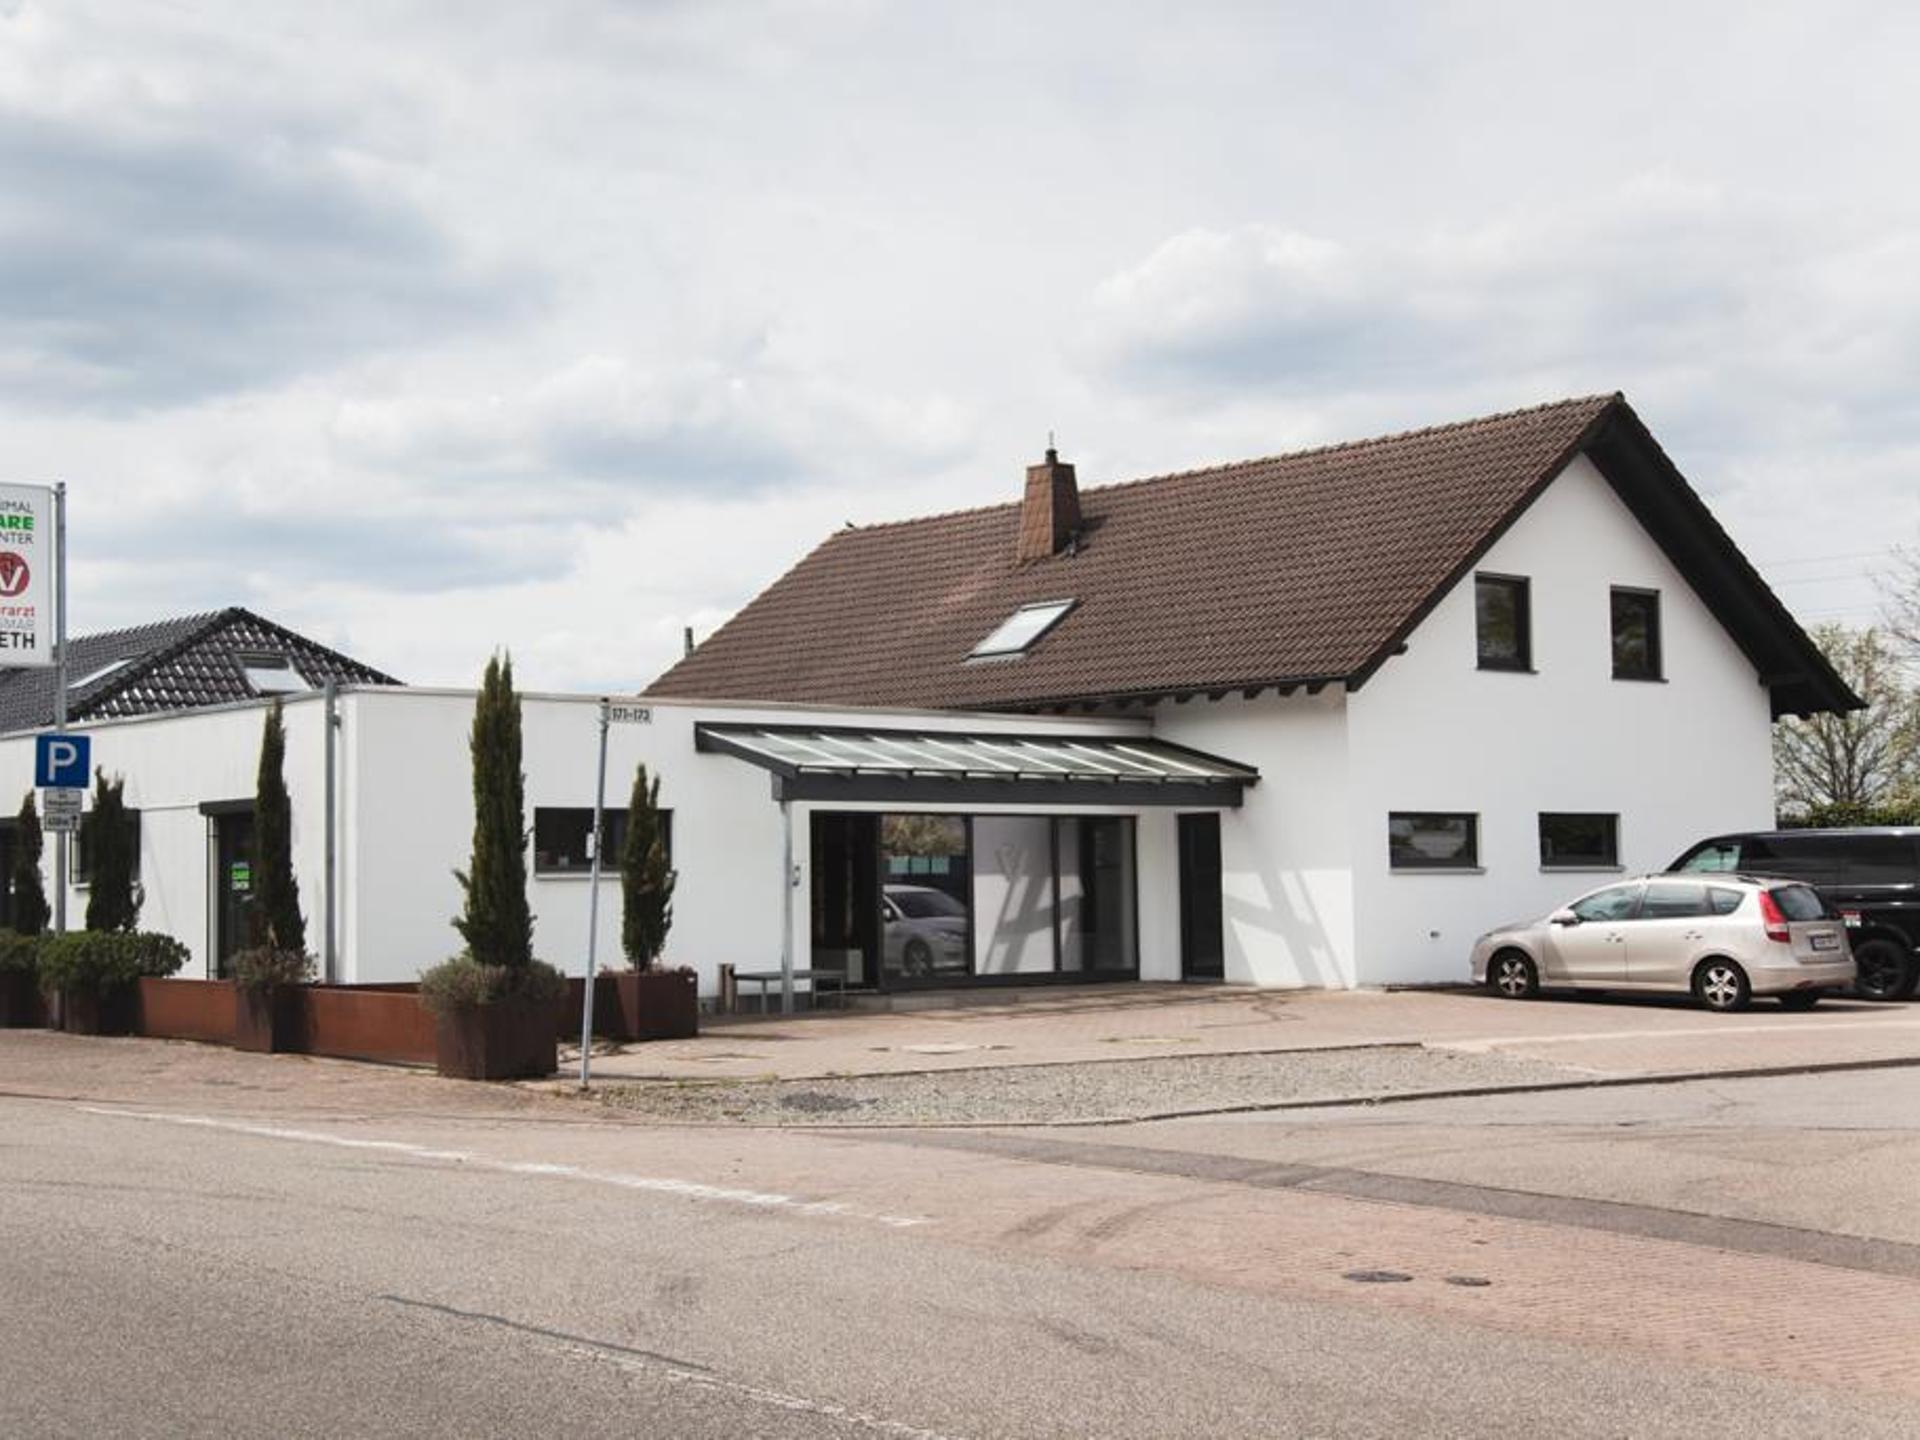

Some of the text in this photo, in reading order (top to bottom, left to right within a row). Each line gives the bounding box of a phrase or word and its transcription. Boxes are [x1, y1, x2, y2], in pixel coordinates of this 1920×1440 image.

[0, 606, 34, 616] rarzt
[0, 631, 34, 649] ETH
[48, 742, 77, 782] P
